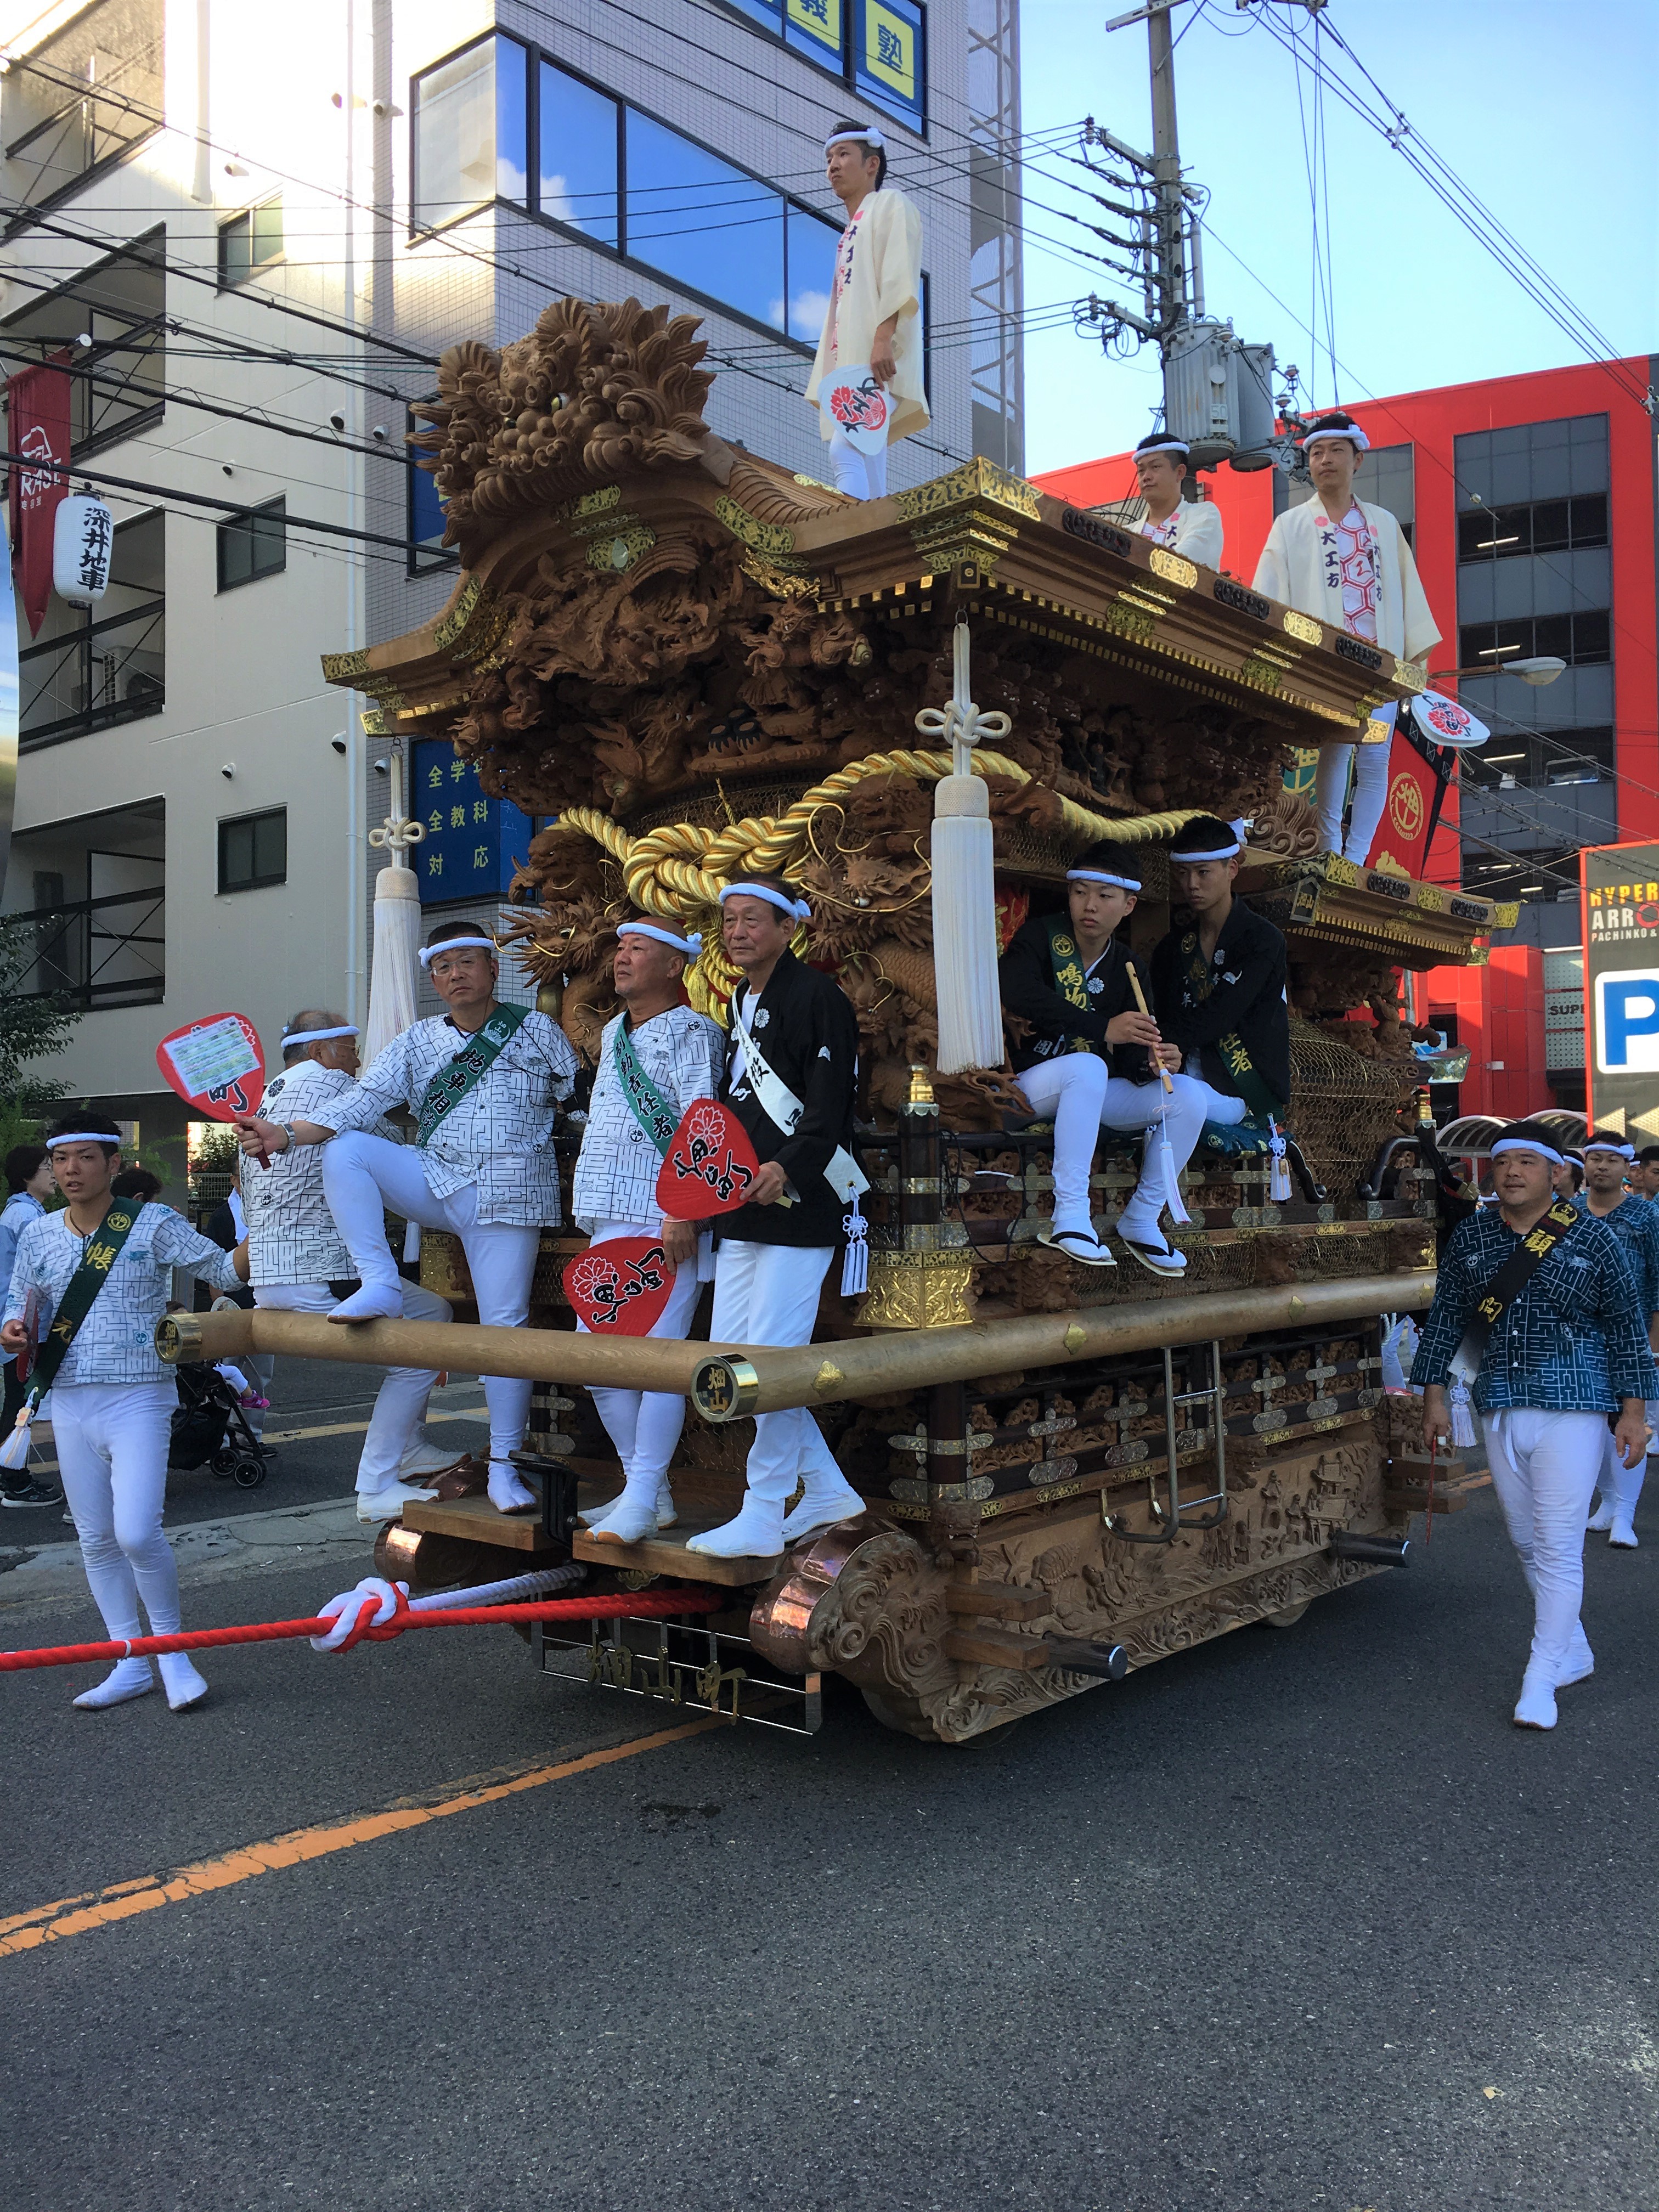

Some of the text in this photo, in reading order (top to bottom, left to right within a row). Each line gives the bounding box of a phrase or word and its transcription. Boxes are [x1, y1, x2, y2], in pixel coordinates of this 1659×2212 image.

[77, 507, 110, 591] 深井地車
[1321, 531, 1339, 589] 大工方
[428, 800, 488, 833] 全教科
[429, 845, 489, 876] 対応
[1590, 882, 1658, 907] HYPER
[1592, 928, 1657, 943] PACHINKO &
[1604, 979, 1659, 1065] P
[616, 1034, 674, 1140] 制動責任者
[708, 1367, 729, 1412] 畑山
